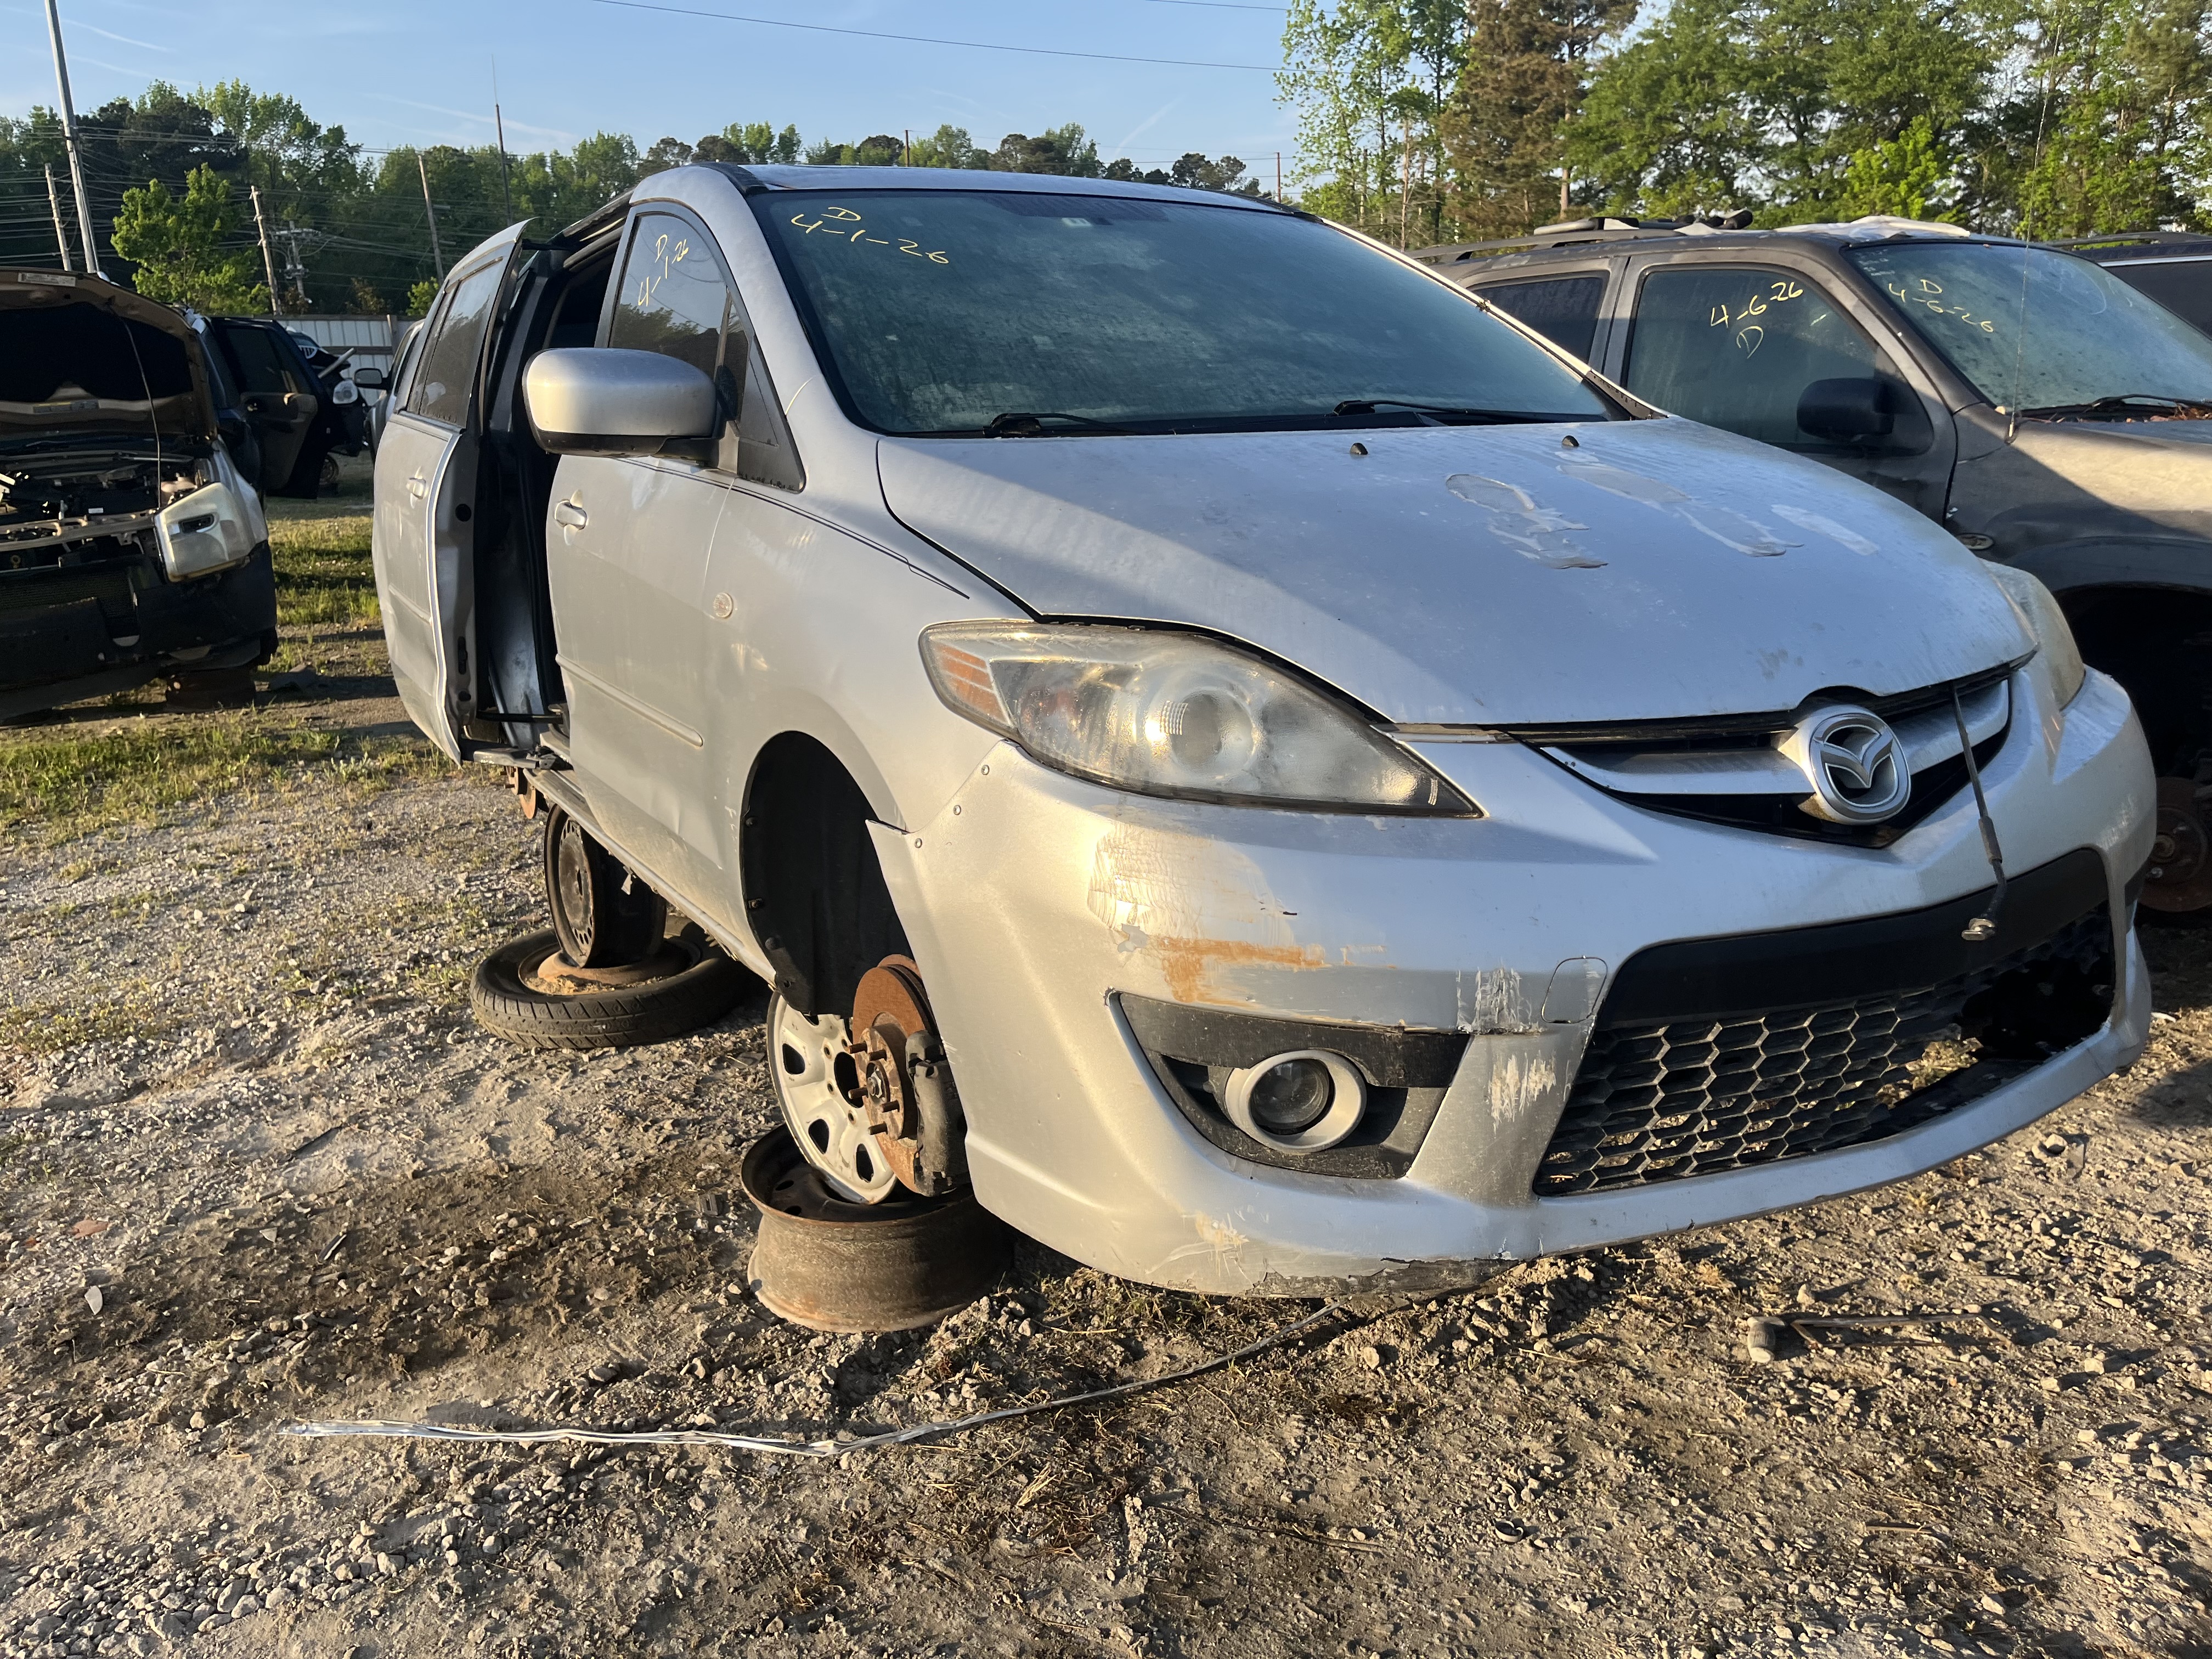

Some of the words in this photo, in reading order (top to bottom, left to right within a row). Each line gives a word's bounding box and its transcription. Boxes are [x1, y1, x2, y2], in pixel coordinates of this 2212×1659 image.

[820, 206, 862, 221] D
[654, 234, 668, 263] D
[791, 213, 949, 264] 4-1-26
[1917, 279, 1943, 294] D
[1709, 281, 1804, 329] 4-6-26
[1888, 283, 1994, 333] 4-6-26
[1736, 325, 1764, 359] D
